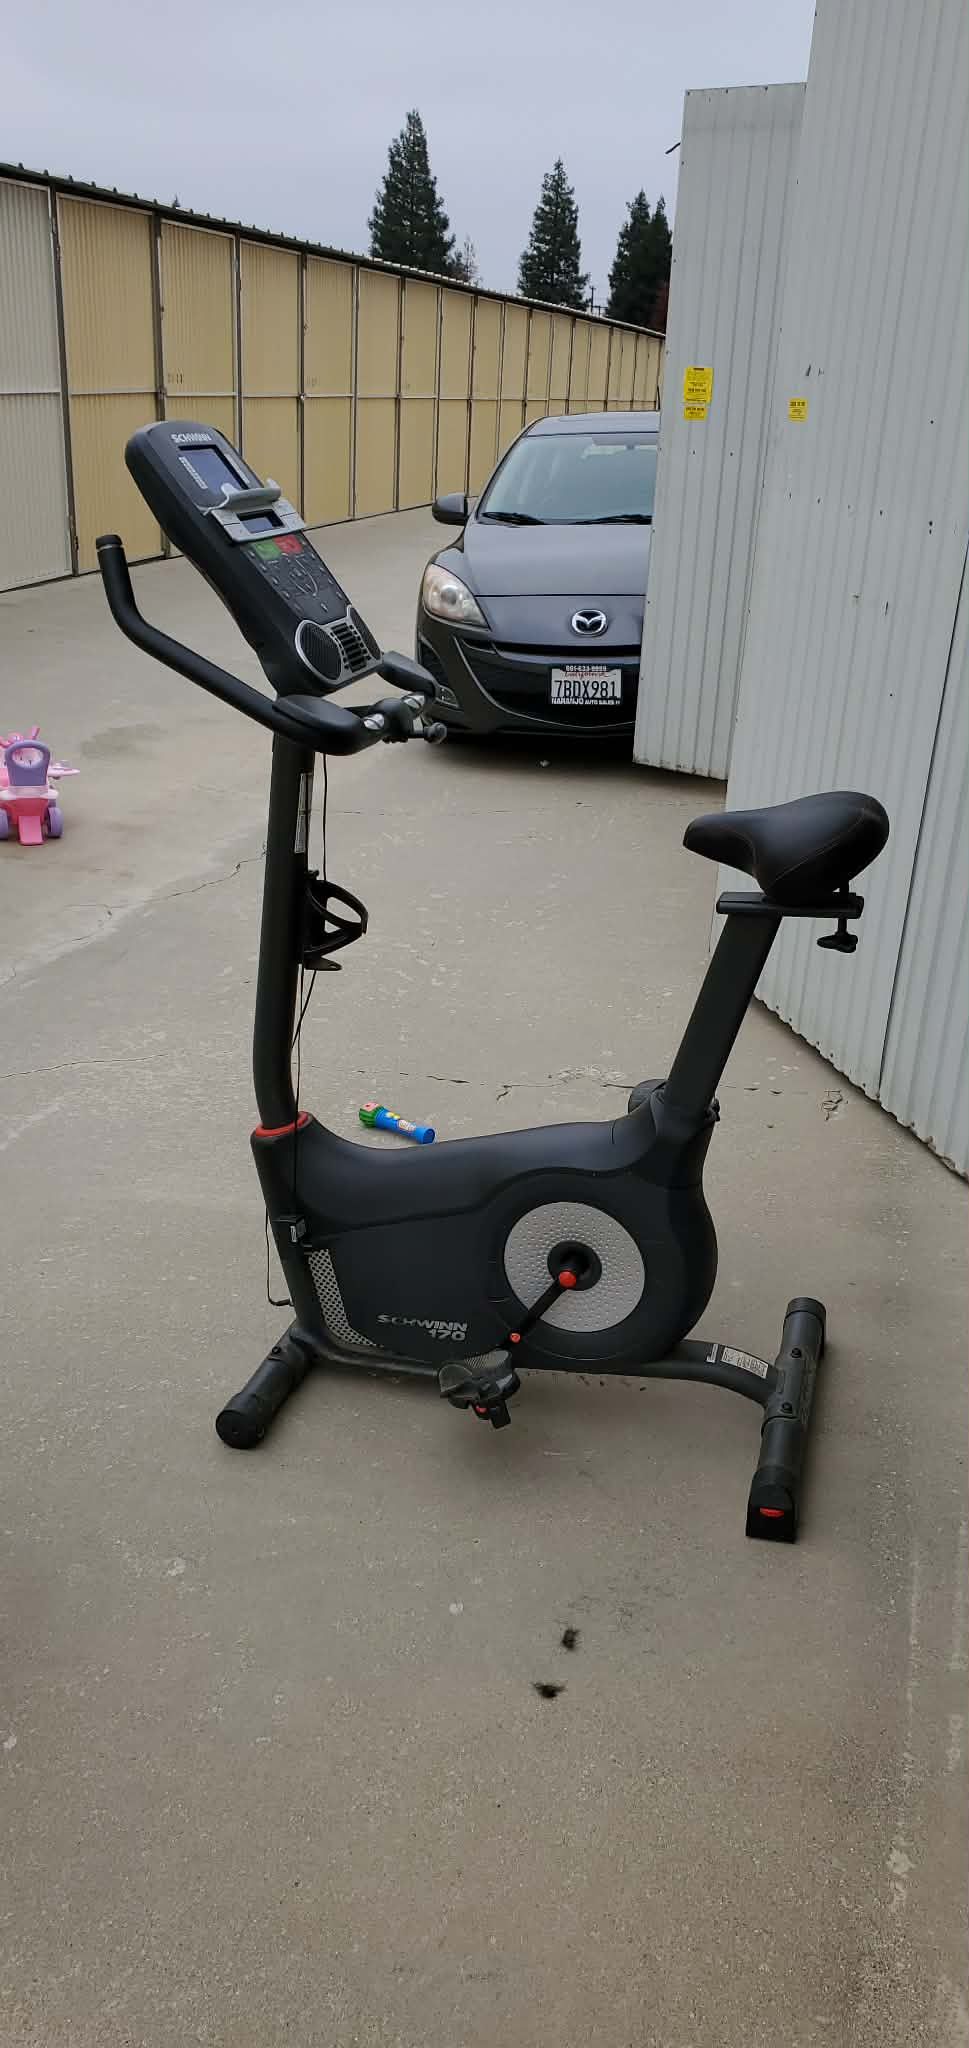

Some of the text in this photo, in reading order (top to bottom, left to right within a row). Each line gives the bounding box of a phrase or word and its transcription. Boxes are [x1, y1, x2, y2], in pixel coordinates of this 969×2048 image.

[171, 433, 212, 443] SCHWINN
[554, 680, 616, 698] 7BDX981
[551, 697, 584, 705] NARANJO
[377, 1314, 468, 1332] SCHWINN
[428, 1329, 466, 1341] 170
